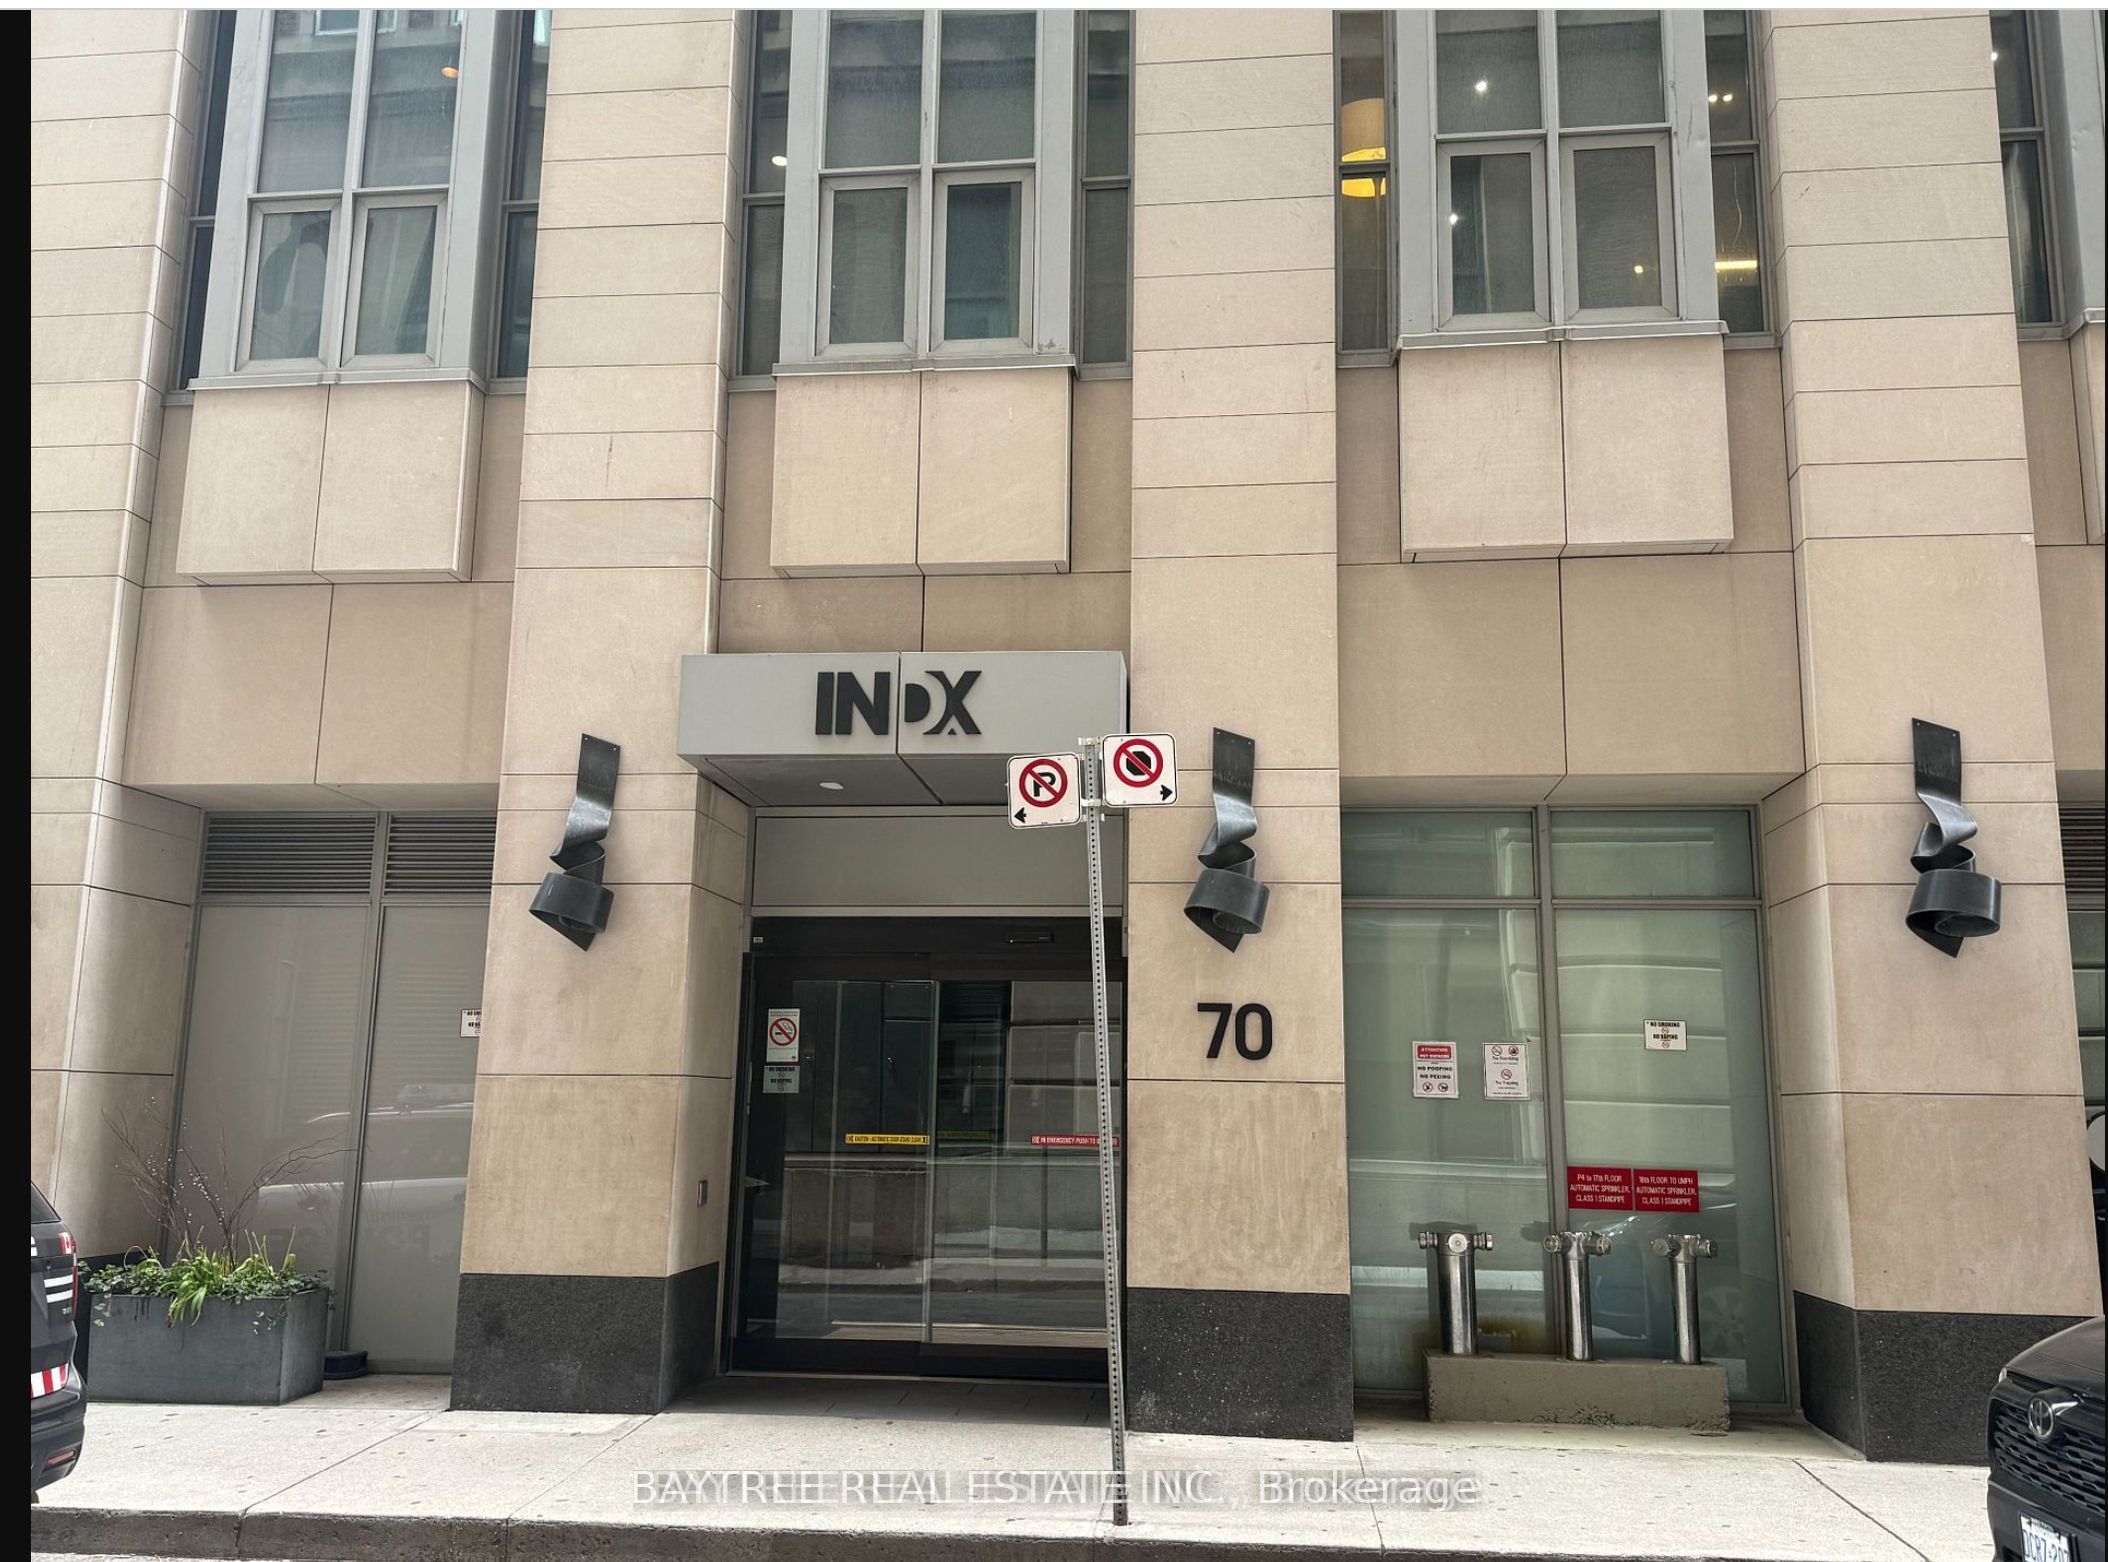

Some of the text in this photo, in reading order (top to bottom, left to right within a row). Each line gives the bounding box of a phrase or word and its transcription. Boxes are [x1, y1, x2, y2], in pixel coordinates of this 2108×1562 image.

[815, 670, 983, 736] INDX
[1197, 1002, 1273, 1061] 70
[1577, 1173, 1585, 1181] P4
[1604, 1174, 1622, 1182] FLOOR
[1650, 1175, 1668, 1184] FLOOR
[1669, 1176, 1677, 1184] TO
[1570, 1183, 1600, 1192] AUTOMATIC
[1636, 1186, 1666, 1195] AUTOMATIC
[1576, 1194, 1594, 1202] CLASS
[1598, 1194, 1625, 1203] STANDPIPE
[1641, 1196, 1660, 1205] CLASS
[1664, 1197, 1692, 1206] STANDPIPE
